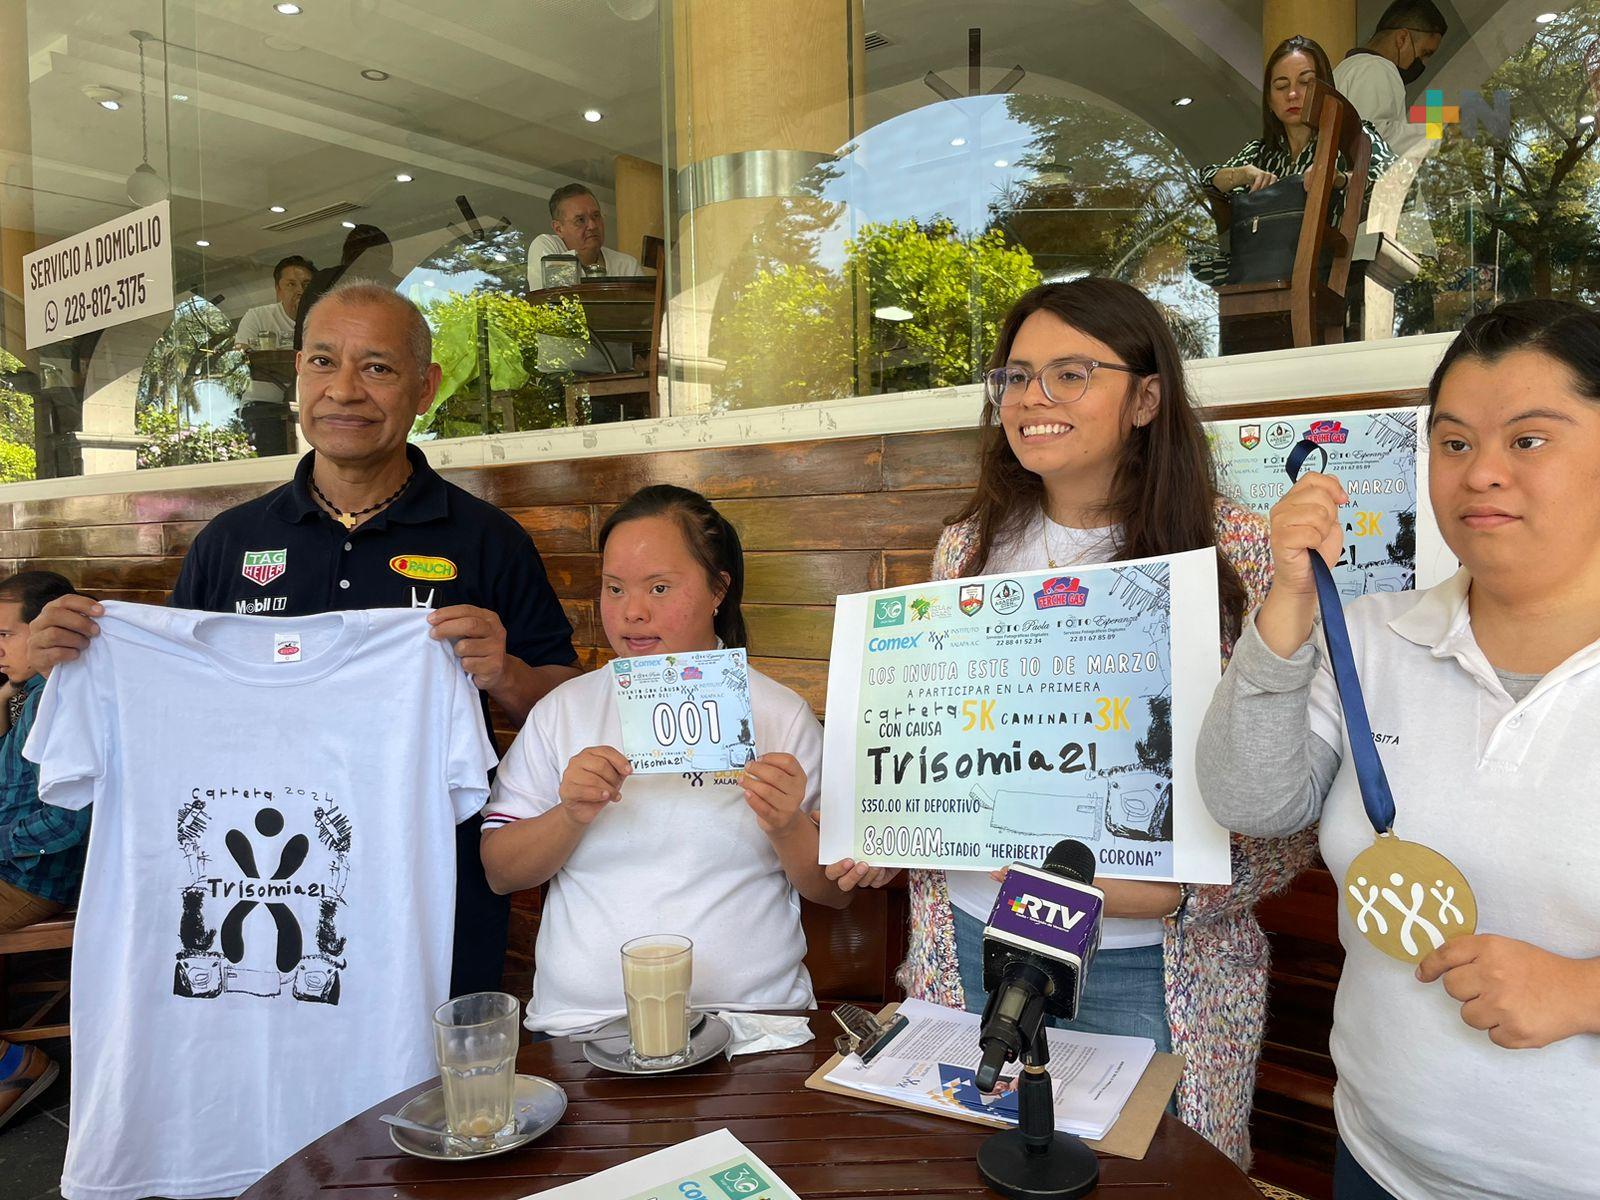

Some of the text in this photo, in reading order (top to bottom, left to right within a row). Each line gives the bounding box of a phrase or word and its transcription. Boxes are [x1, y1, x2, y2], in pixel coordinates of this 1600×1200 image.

[30, 215, 161, 290] SERVICIO A DOMICILIO
[64, 273, 146, 326] 228-812-3175
[1251, 483, 1284, 498] ESTE
[1348, 479, 1406, 494] MARZO
[1354, 511, 1384, 537] 3K
[250, 553, 285, 565] TAG
[408, 560, 451, 576] RAUCH
[244, 565, 284, 584] HEUER
[235, 598, 271, 615] Mobil
[1038, 593, 1085, 609] FERCHE GAS
[1022, 619, 1050, 632] Paola
[1093, 615, 1139, 629] Esperanza
[868, 631, 924, 653] Comex
[868, 651, 1158, 686] LOS INVITA ESTE 10 DE MARZO
[907, 682, 1101, 698] A PARTICIPAR EN LA PRIMERA
[652, 699, 721, 747] 001
[962, 699, 997, 732] 5K
[1001, 712, 1093, 725] CAMINATA
[1094, 697, 1131, 732] 3K
[879, 721, 942, 738] CON CAUSA
[284, 786, 334, 808] 2024
[861, 799, 902, 813] $350.00
[863, 825, 943, 857] 8:00AM
[1020, 893, 1087, 930] RTV
